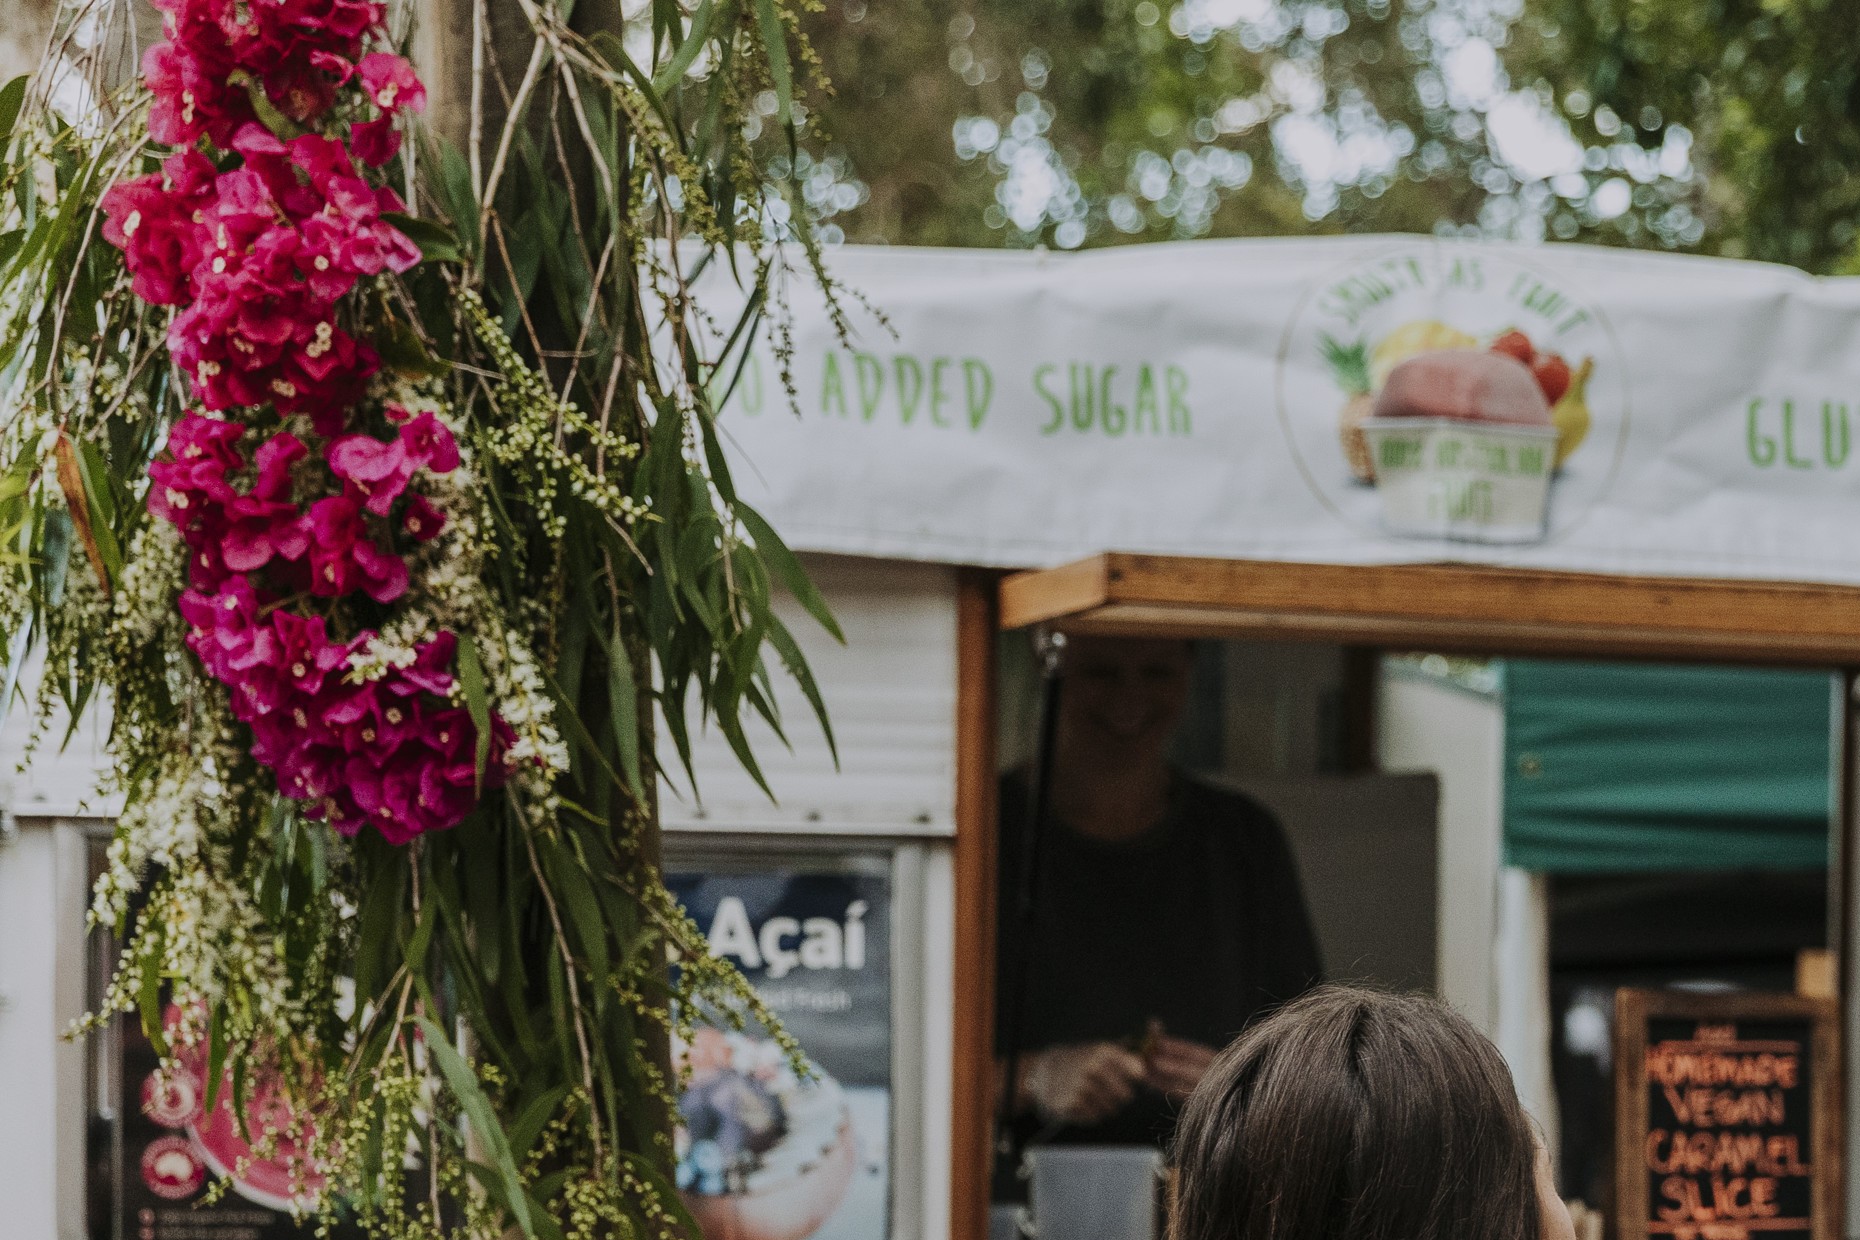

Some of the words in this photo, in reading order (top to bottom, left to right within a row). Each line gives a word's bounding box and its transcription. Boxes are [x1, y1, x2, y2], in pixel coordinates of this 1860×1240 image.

[820, 350, 996, 434] ADDED
[1032, 361, 1195, 438] SUGAR
[707, 894, 869, 980] Açaí
